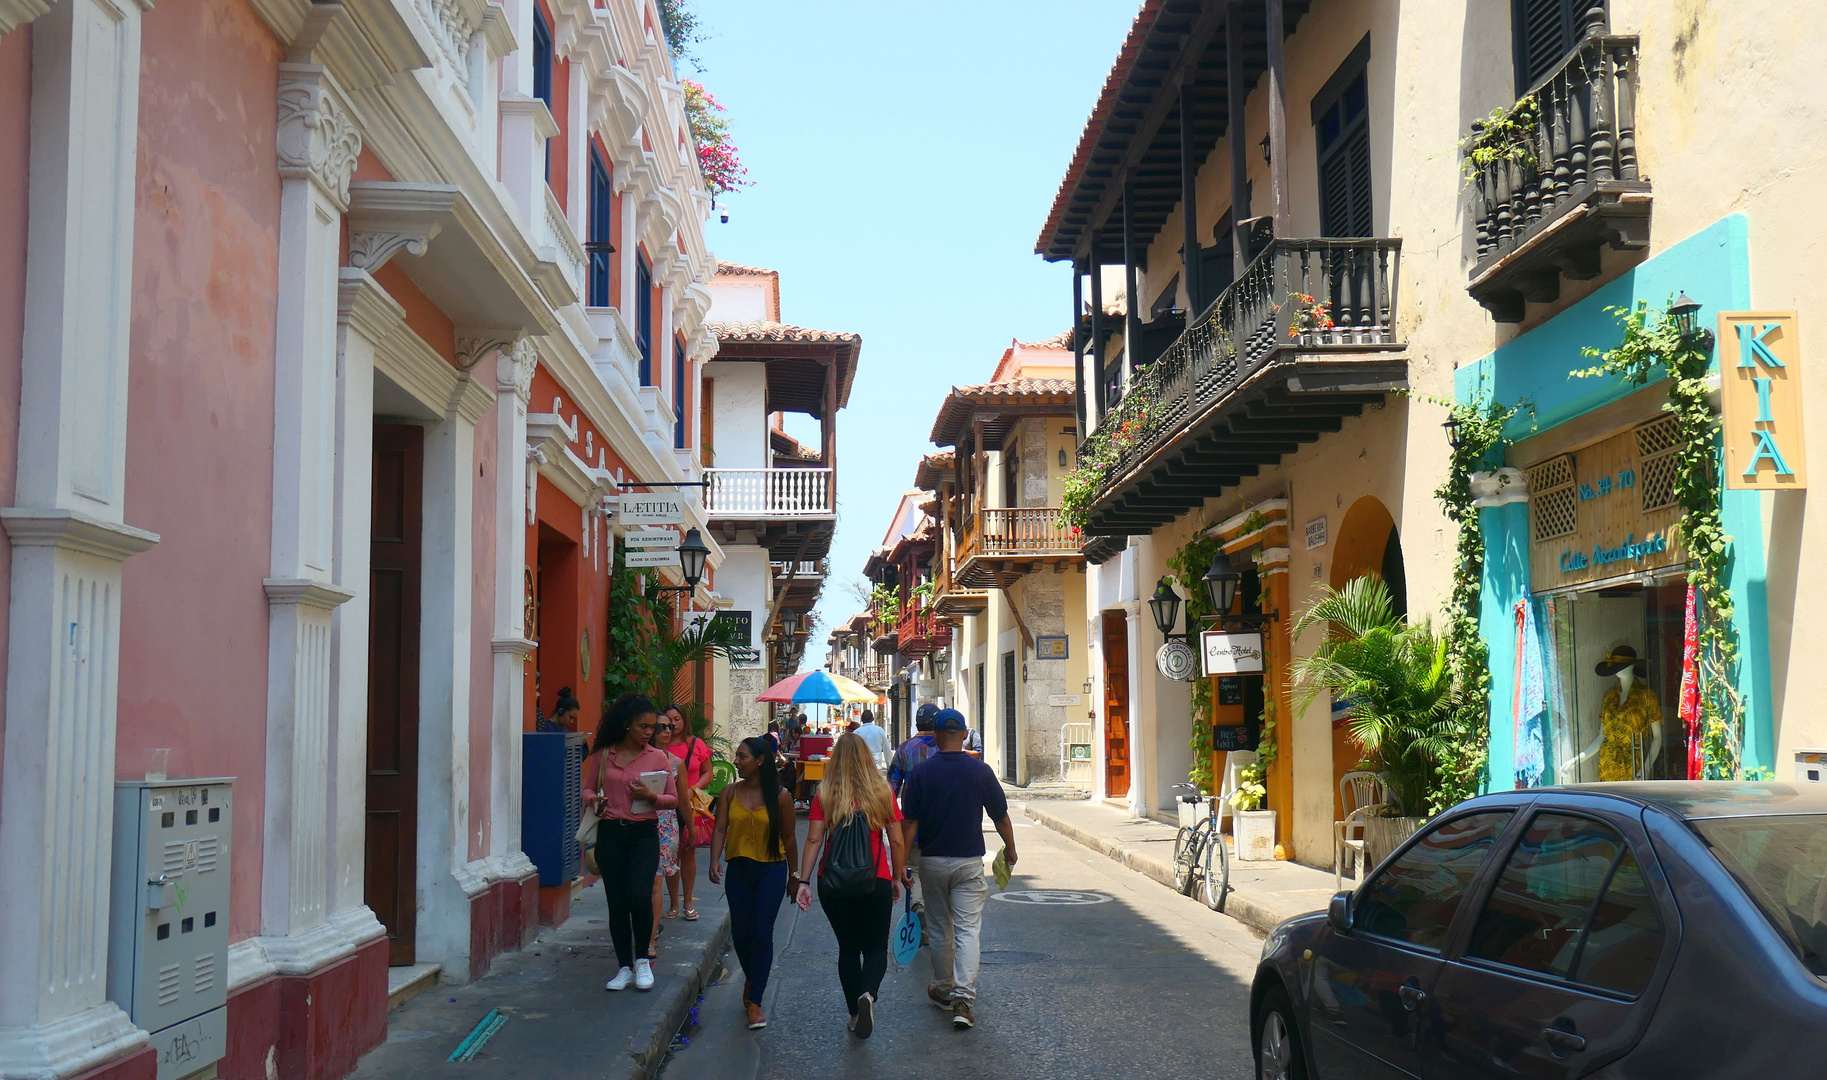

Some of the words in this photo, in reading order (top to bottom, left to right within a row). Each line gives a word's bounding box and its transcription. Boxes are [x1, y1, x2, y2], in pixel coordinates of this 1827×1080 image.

[1734, 323, 1795, 475] KIA
[1596, 469, 1636, 497] 34-70
[1559, 550, 1589, 573] Calle
